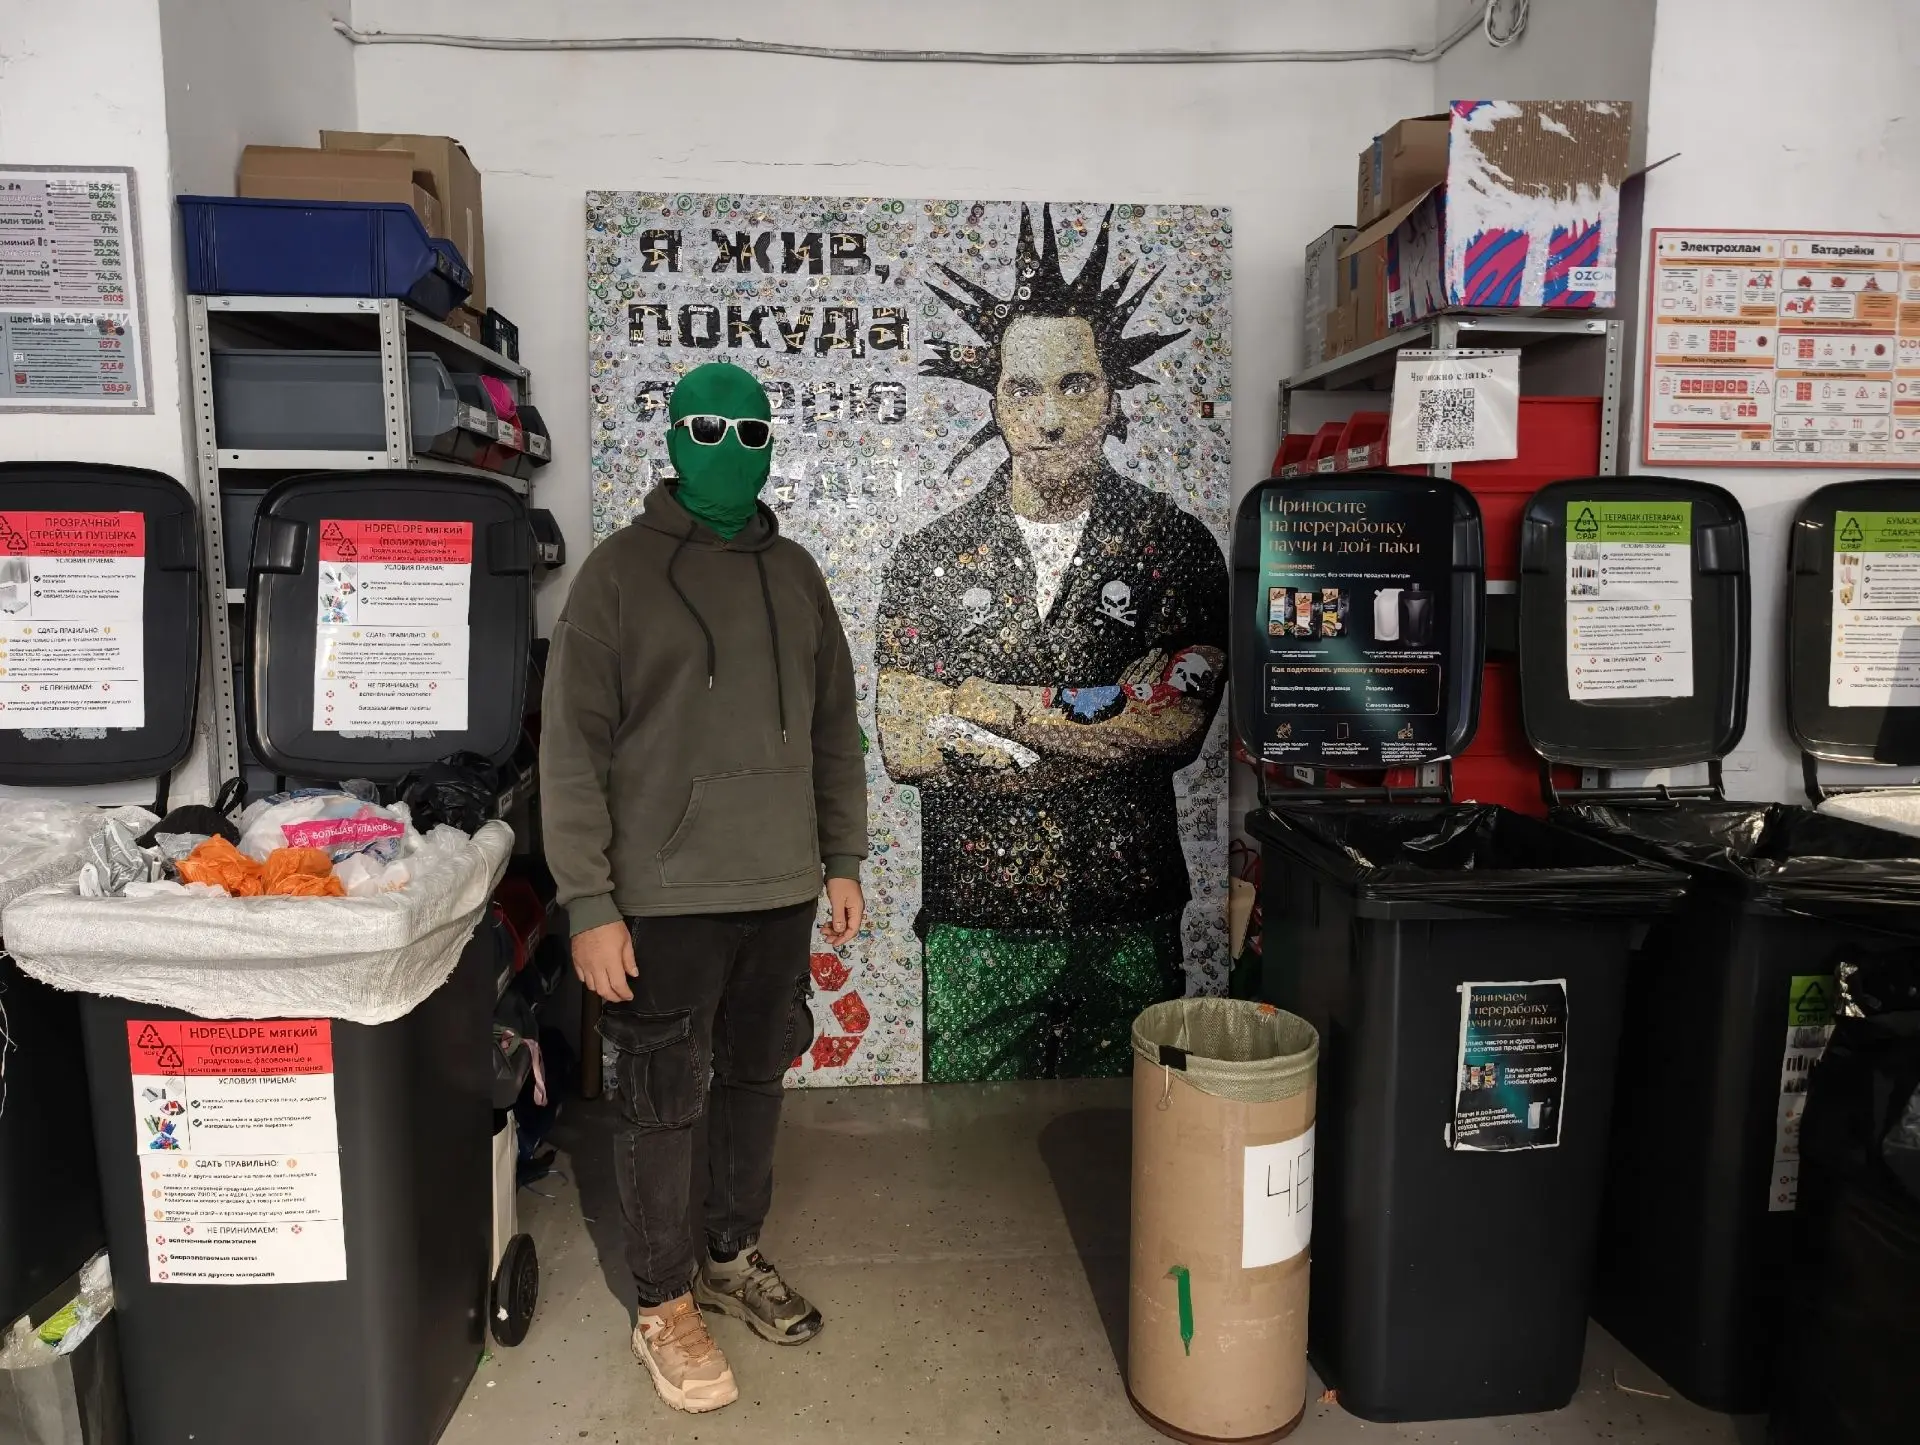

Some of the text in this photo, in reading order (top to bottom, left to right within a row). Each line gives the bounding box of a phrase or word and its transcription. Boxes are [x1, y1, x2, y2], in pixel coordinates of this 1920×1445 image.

[1680, 241, 1761, 255] Электрохлам
[1811, 243, 1875, 256] Батарейки
[1575, 271, 1612, 281] OZON
[1269, 496, 1367, 516] Приносите
[45, 517, 120, 527] ПРОЗРАЧНЫЙ
[365, 524, 463, 535] HDPE\LDPE мягкий
[1269, 518, 1406, 537] на переработку
[30, 529, 136, 540] СТРЕЙЧ И ПУПЫРКА
[379, 538, 447, 547] (полиэтилен)
[1269, 538, 1420, 556] паучи и дой-паки
[1475, 1003, 1549, 1017] переработку
[1504, 1015, 1557, 1028] дой-паки
[190, 1026, 318, 1039] HDPE\LDPE мягкий
[148, 1034, 154, 1043] 2
[210, 1043, 299, 1056] (полиэтилен)
[1504, 1044, 1535, 1052] продукта
[167, 1055, 173, 1063] 4
[254, 1056, 305, 1065] фасовочные
[260, 1066, 293, 1074] цветная
[218, 1076, 297, 1085] УСЛОВИЯ ПРИЕМА:
[196, 1159, 279, 1168] СДАТЬ ПРАВИЛЬНО:
[219, 1226, 278, 1234] ПРИНИМАЕМ:
